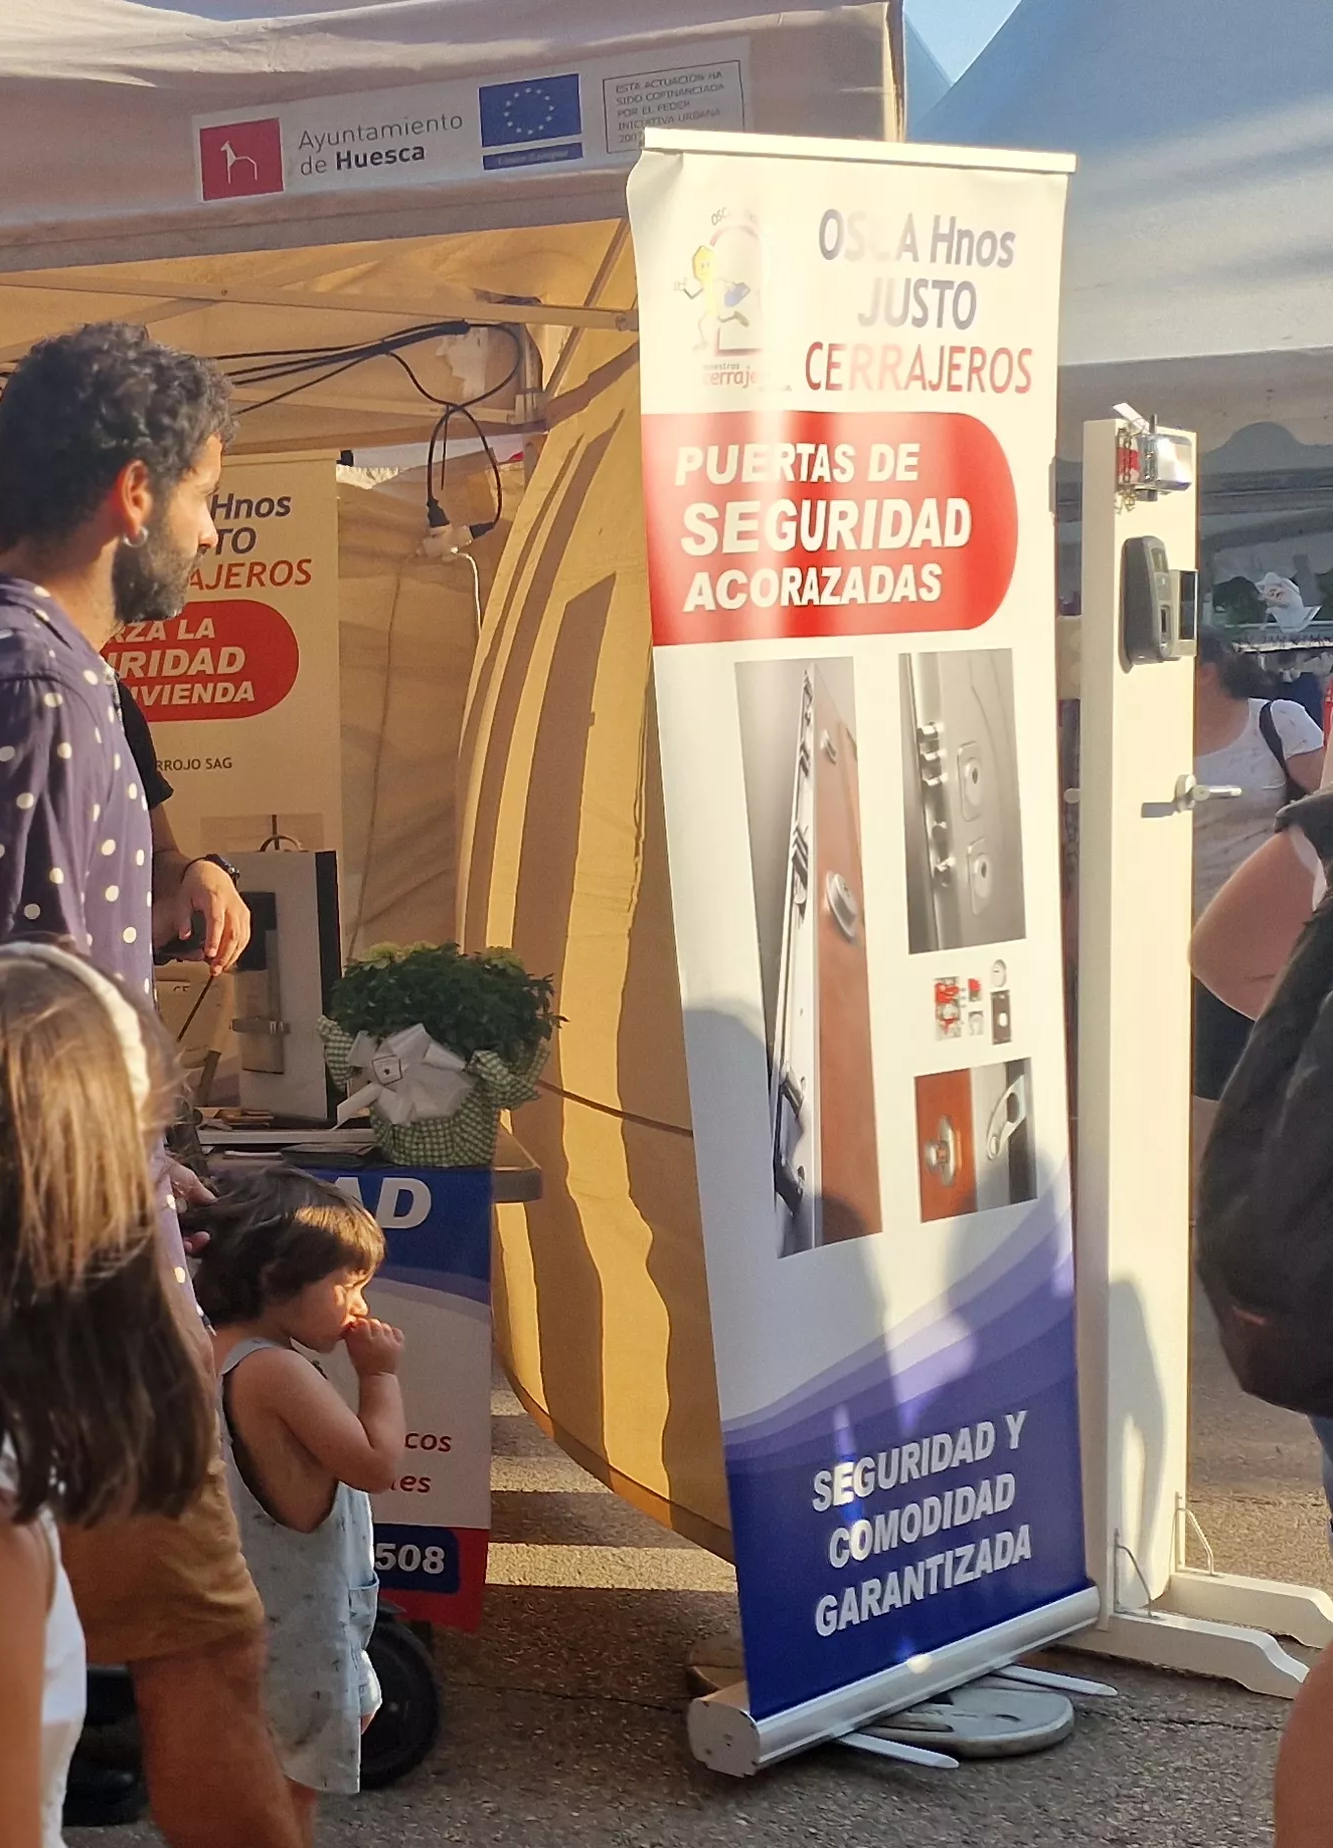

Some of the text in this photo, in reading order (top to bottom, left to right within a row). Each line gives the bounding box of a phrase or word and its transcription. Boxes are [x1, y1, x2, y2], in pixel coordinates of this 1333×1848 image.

[298, 112, 463, 153] Ayuntamiento
[301, 144, 426, 175] de Huesca
[929, 214, 1016, 268] Hnos
[857, 277, 977, 330] JUSTO
[805, 341, 1033, 394] CERRAJEROS
[675, 442, 921, 486] PUERTAS DE
[211, 493, 291, 520] Hnos
[681, 497, 972, 556] SEGURIDAD
[189, 558, 313, 590] AJEROS
[681, 563, 942, 612] ACORAZADAS
[177, 618, 216, 640] LA
[110, 646, 246, 680] RIDAD
[131, 681, 255, 706] VIENDA
[155, 757, 233, 771] RROJO SAG
[812, 1410, 1028, 1512] SEGURIDAD Y
[829, 1473, 1016, 1569] COMODIDAD
[815, 1524, 1031, 1637] GARANTIZADA
